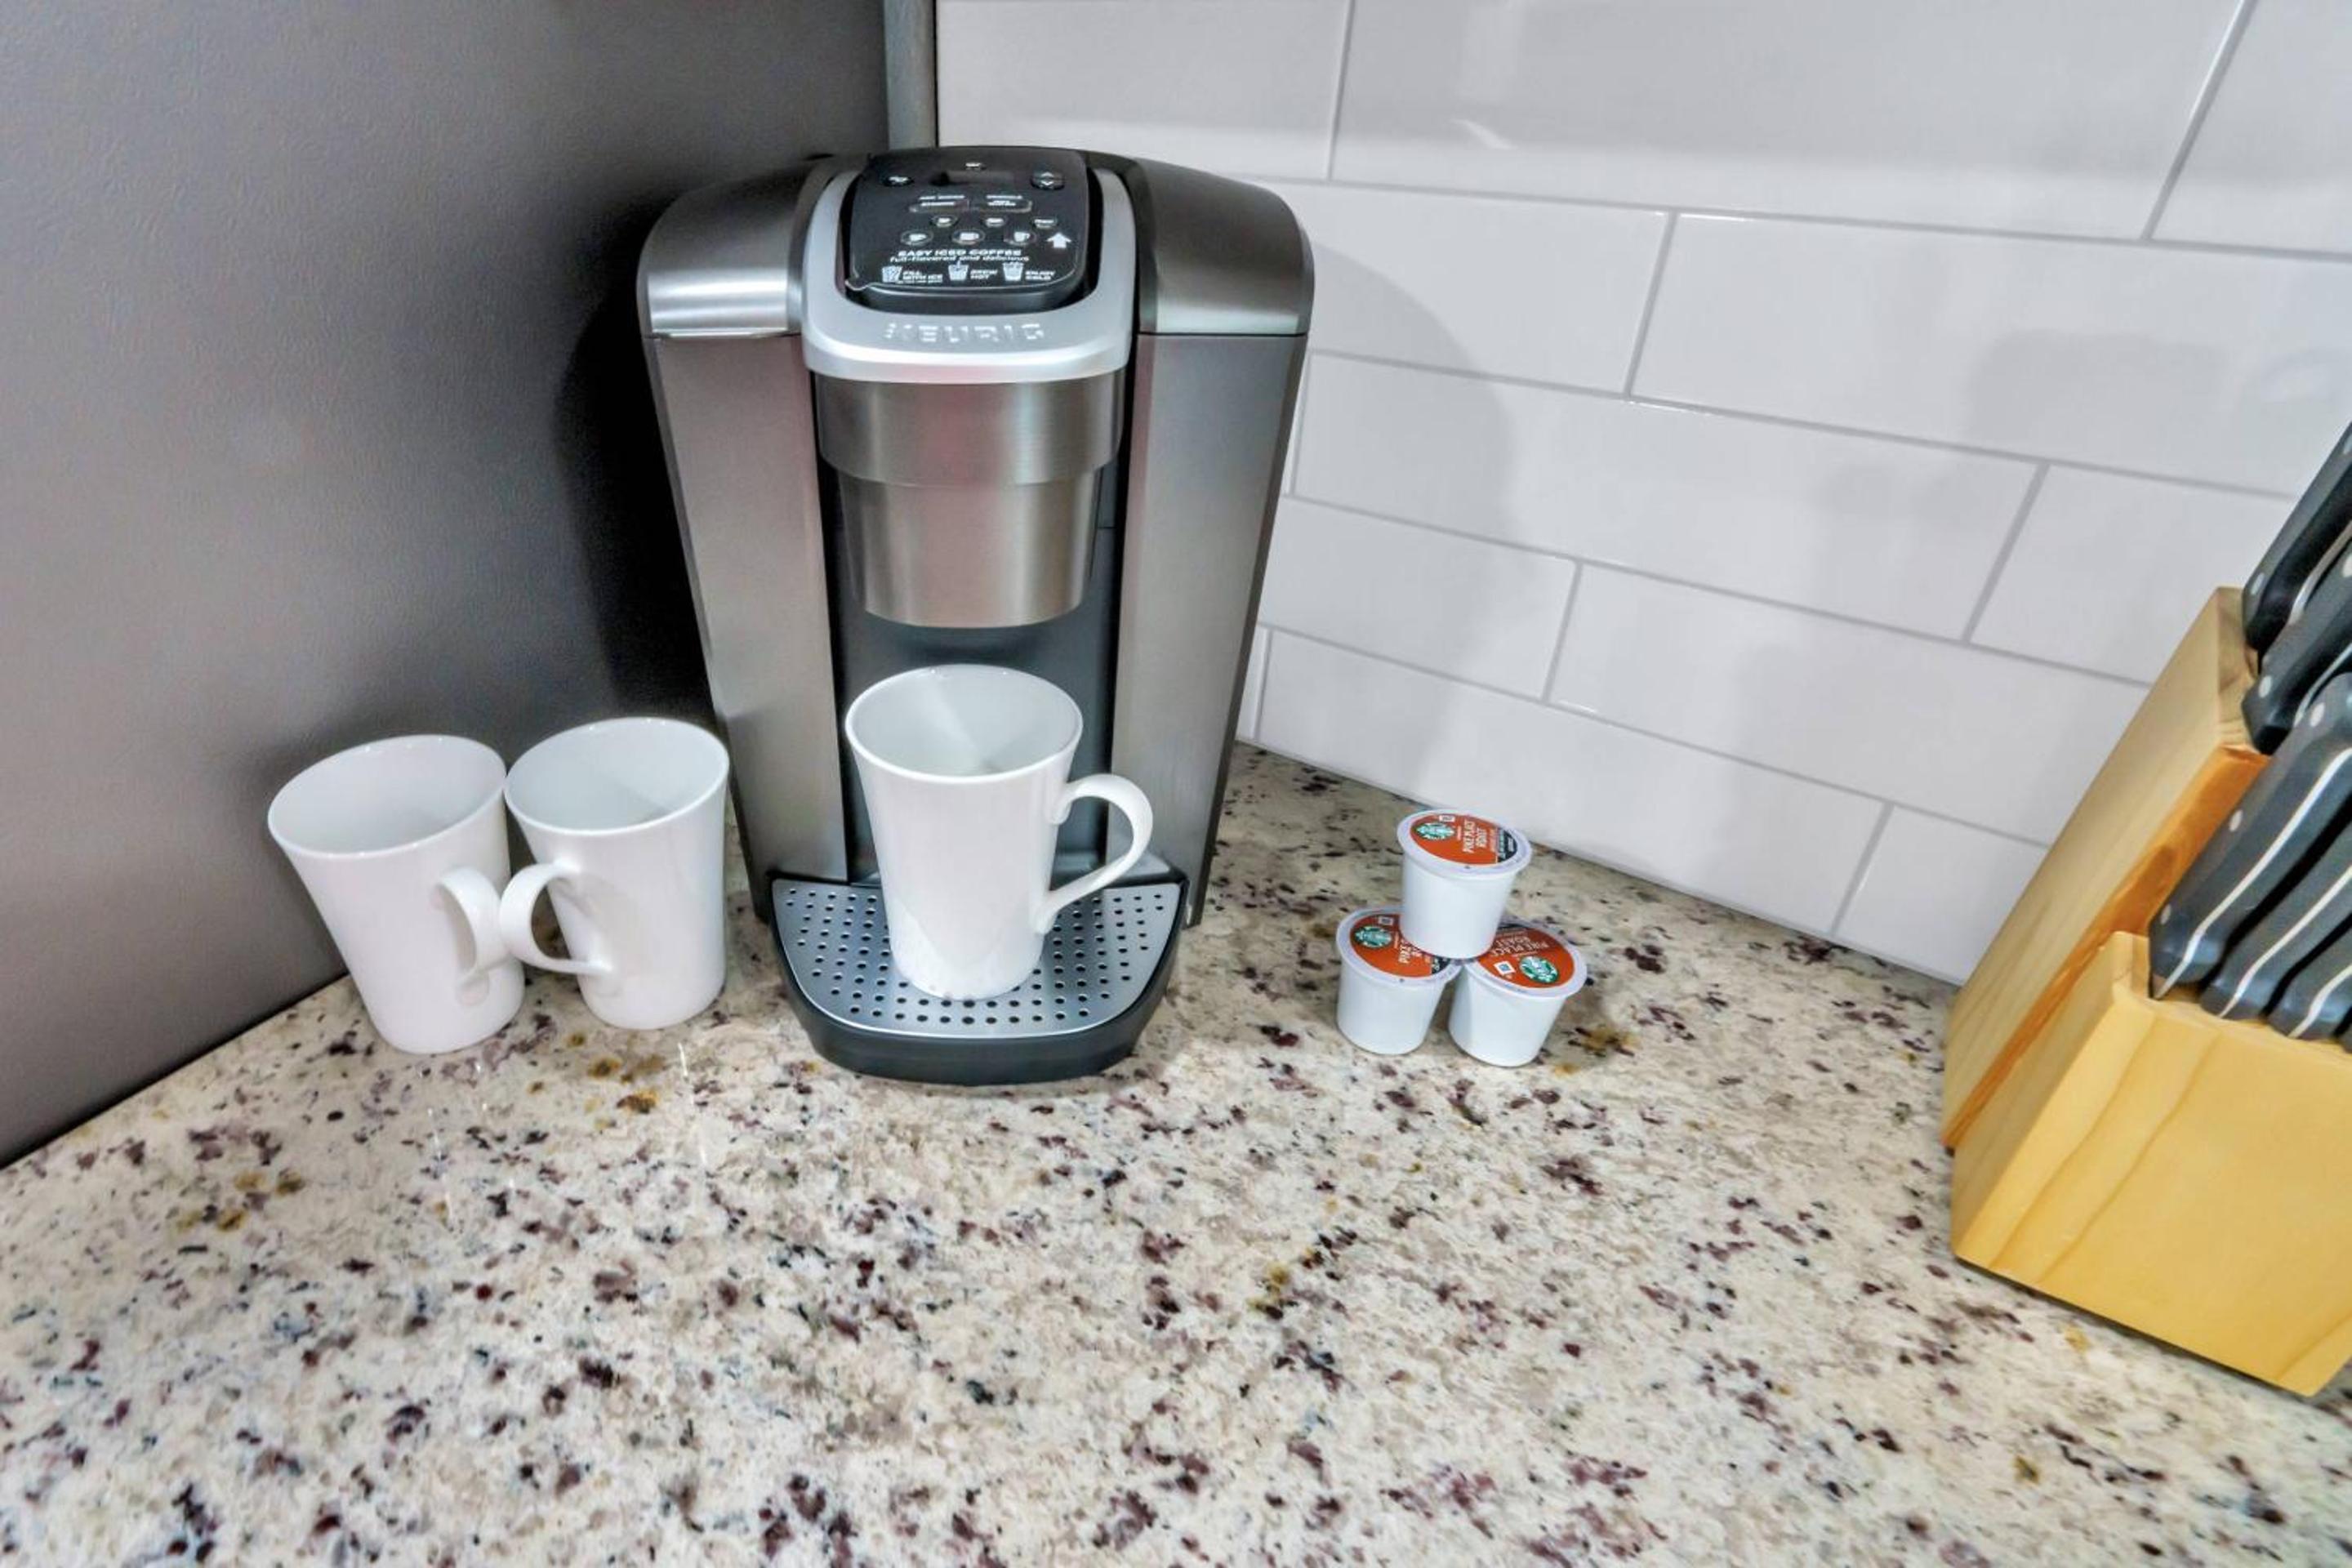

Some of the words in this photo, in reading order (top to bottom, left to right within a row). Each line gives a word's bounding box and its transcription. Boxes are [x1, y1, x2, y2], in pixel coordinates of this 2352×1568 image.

[934, 248, 966, 256] ICED
[969, 248, 1022, 256] COFFEE
[884, 322, 1045, 343] KEURIG
